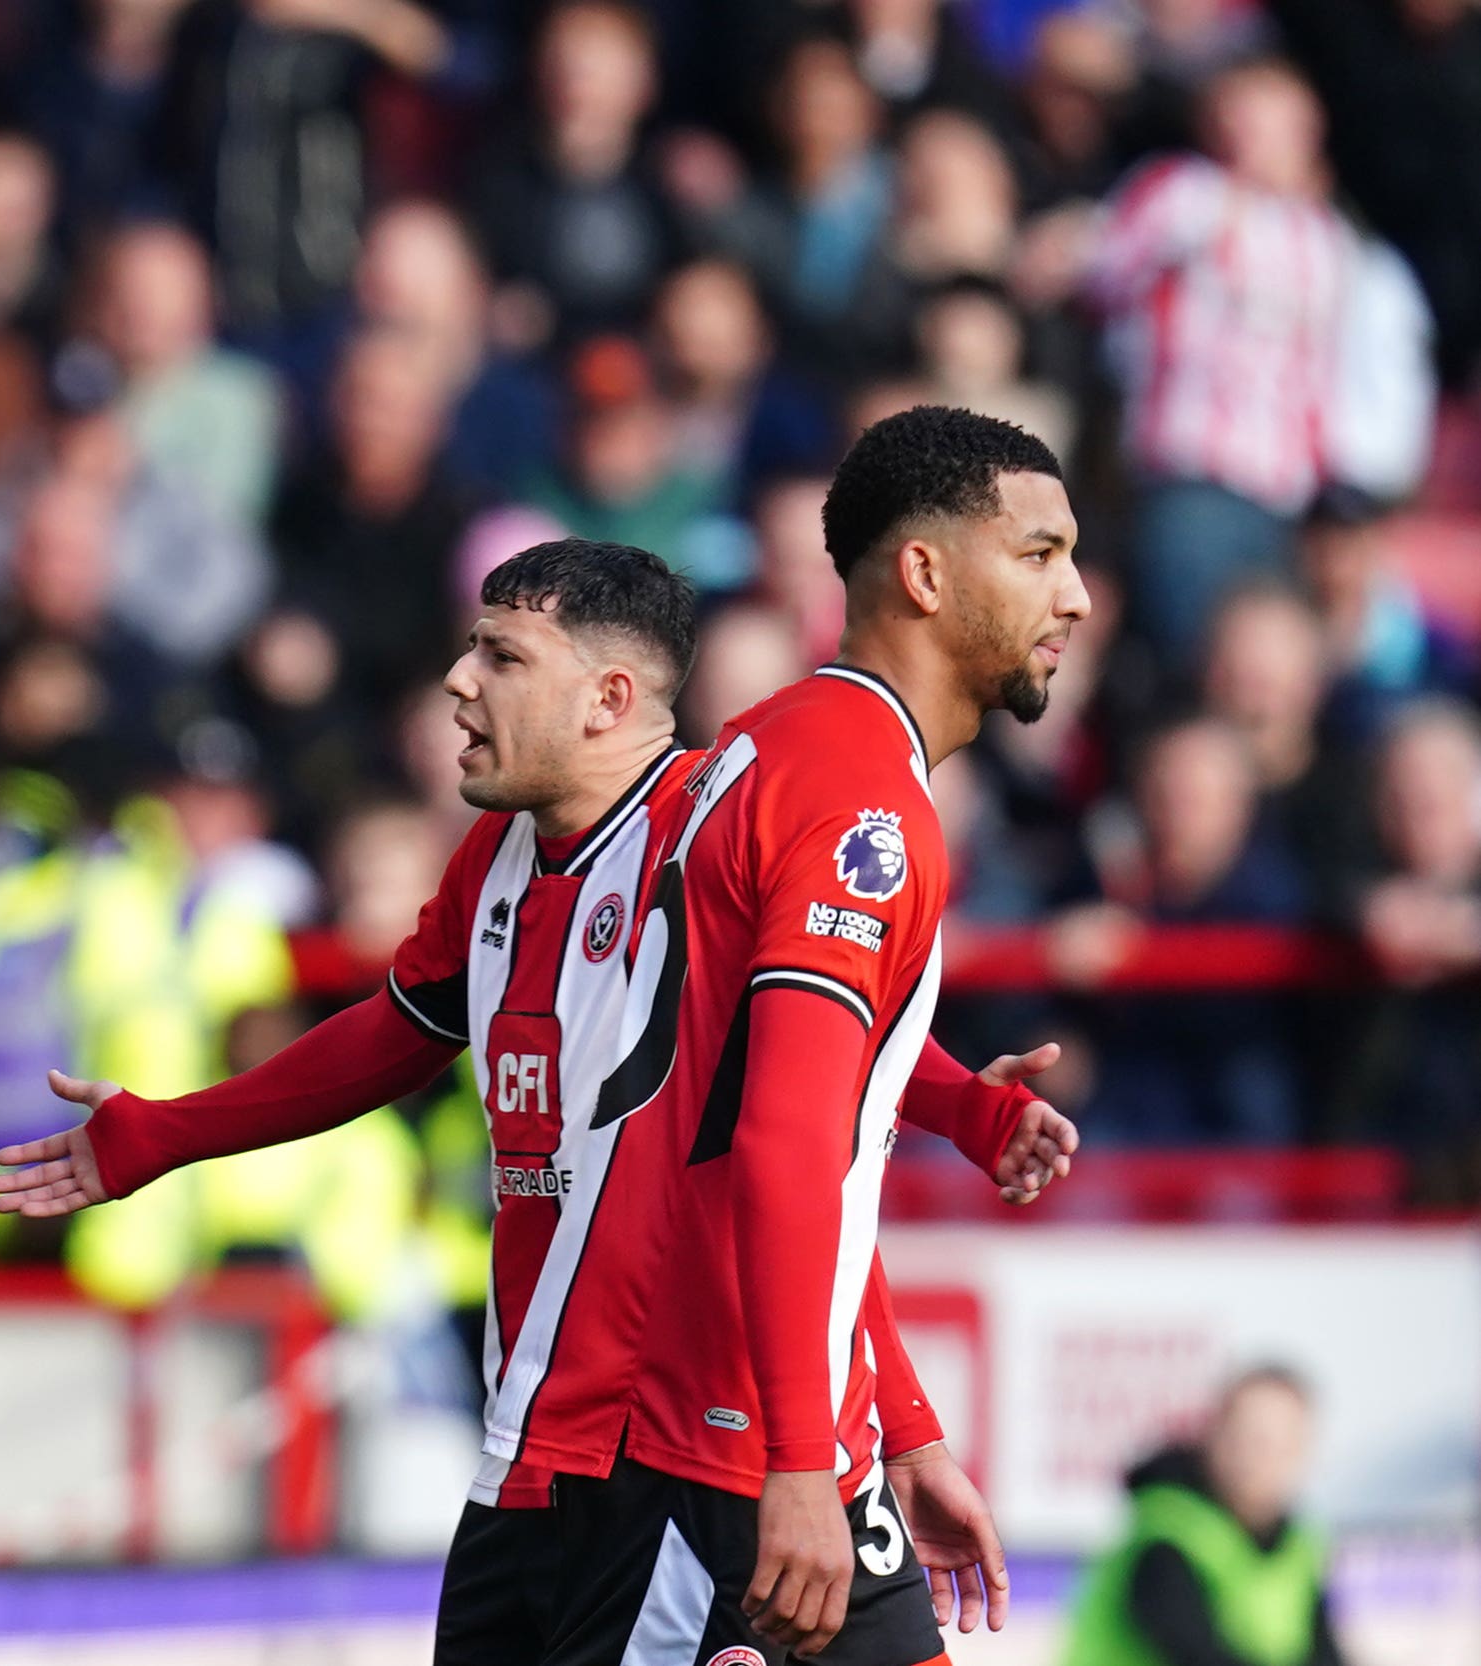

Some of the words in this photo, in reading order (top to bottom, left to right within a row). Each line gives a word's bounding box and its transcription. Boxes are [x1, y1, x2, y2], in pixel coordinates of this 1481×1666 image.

[805, 919, 835, 936] for
[807, 901, 838, 923] No
[838, 910, 883, 937] room
[497, 1052, 549, 1114] CFI
